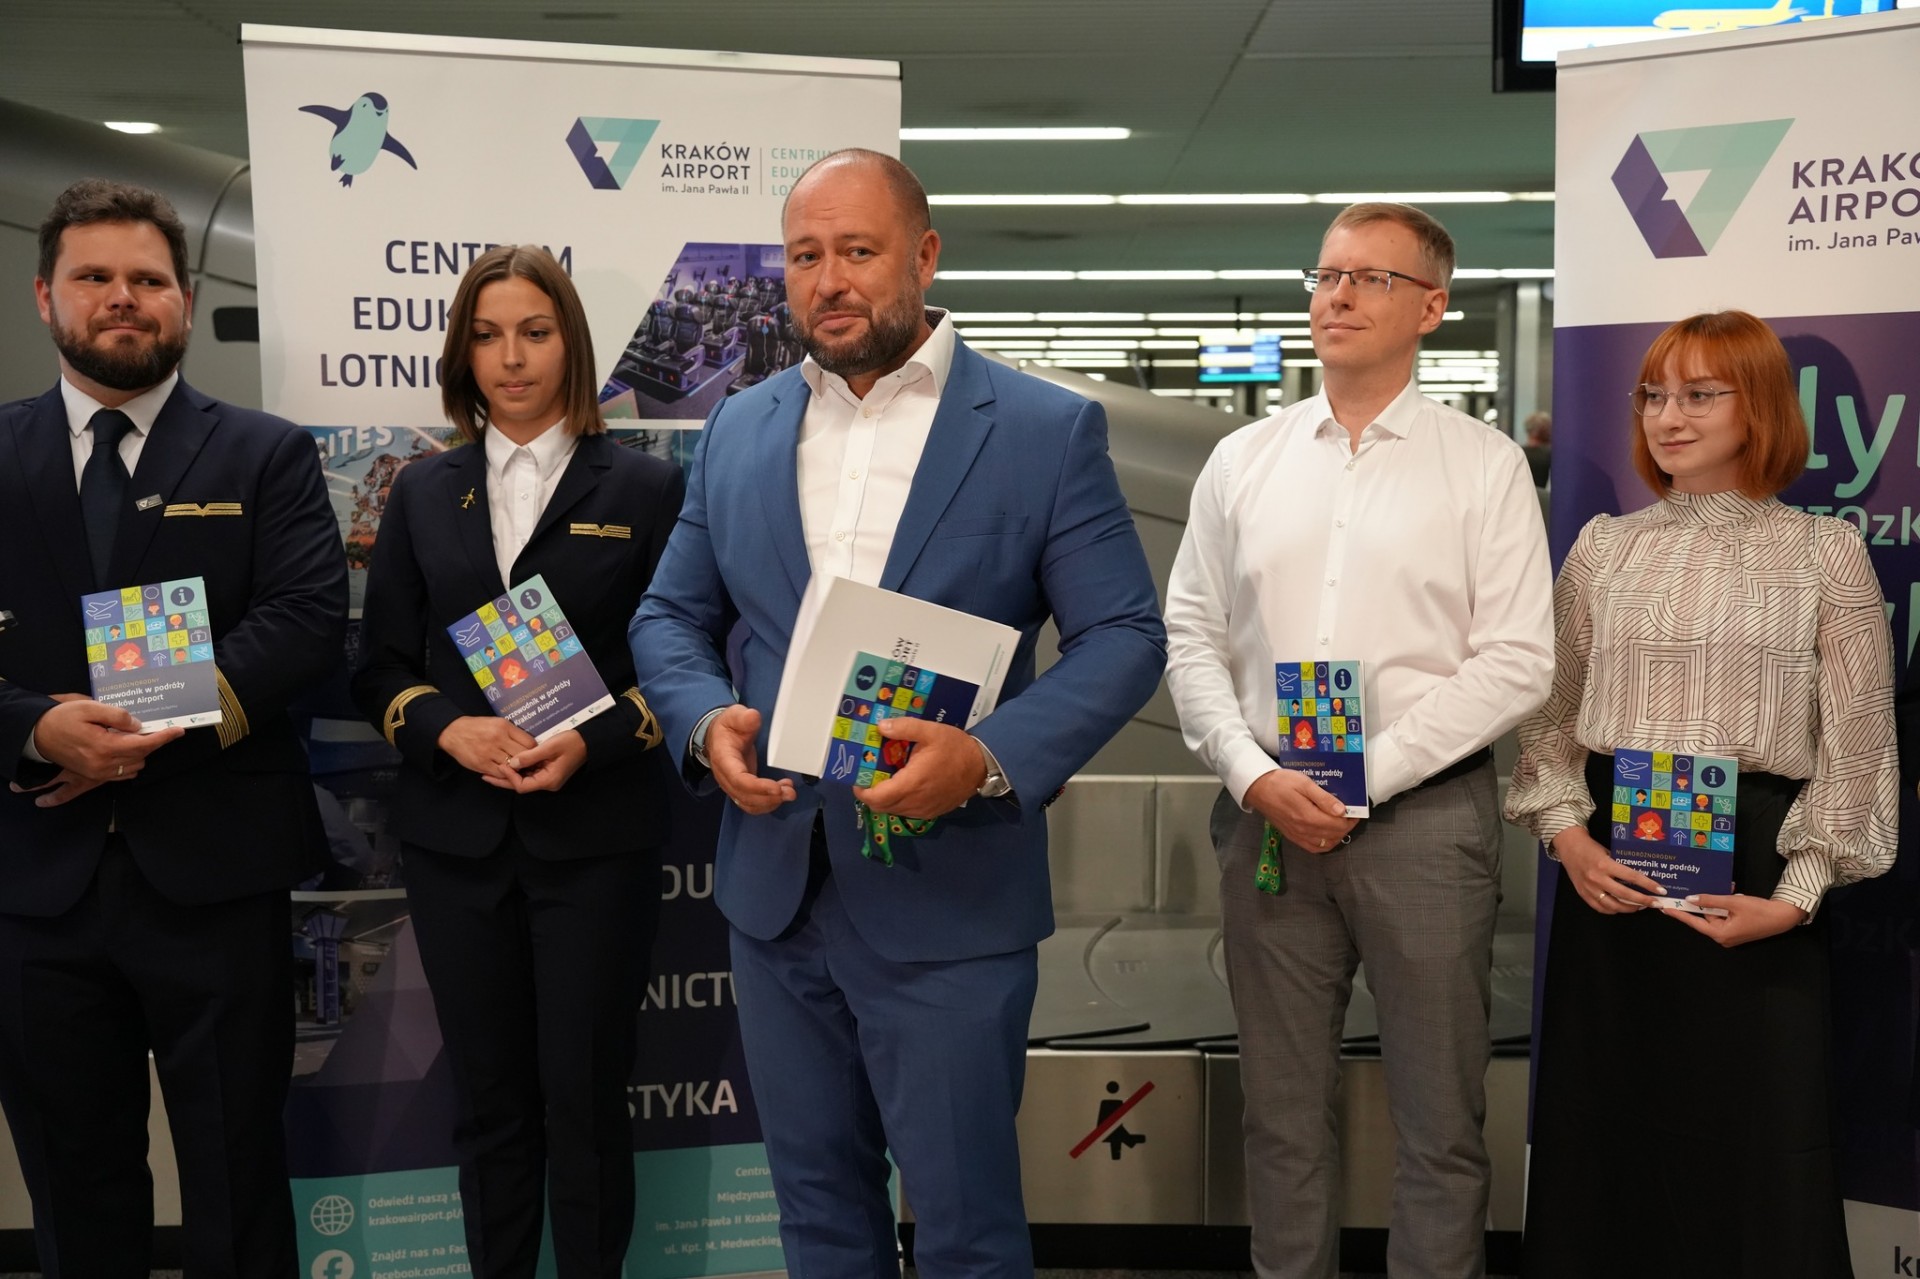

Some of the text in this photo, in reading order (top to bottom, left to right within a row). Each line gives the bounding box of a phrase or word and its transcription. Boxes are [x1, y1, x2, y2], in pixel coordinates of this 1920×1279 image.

[661, 142, 750, 161] KRAKÓW
[661, 163, 750, 180] AIRPORT
[662, 183, 678, 193] im.
[681, 184, 705, 194] Jana
[708, 184, 739, 195] Pawła
[1788, 235, 1820, 252] im.
[1827, 232, 1877, 250] Jana
[98, 688, 144, 703] przewodnik
[154, 681, 185, 693] podróży
[546, 678, 571, 698] podróży
[137, 694, 164, 705] Airport
[536, 697, 560, 716] Airport
[1321, 769, 1343, 778] podróży
[1615, 858, 1659, 869] przewodnik
[1669, 863, 1700, 874] podróży
[1651, 870, 1678, 880] Airport
[368, 1194, 415, 1209] Odwiedź
[417, 1193, 448, 1204] naszą
[368, 1208, 464, 1227] krakowairport.pl/
[674, 1219, 698, 1231] Jana
[701, 1215, 732, 1227] Pawła
[371, 1248, 407, 1263] Znajdź
[410, 1248, 429, 1258] nas
[432, 1246, 445, 1256] na
[371, 1262, 471, 1279] facebook.com/CEL
